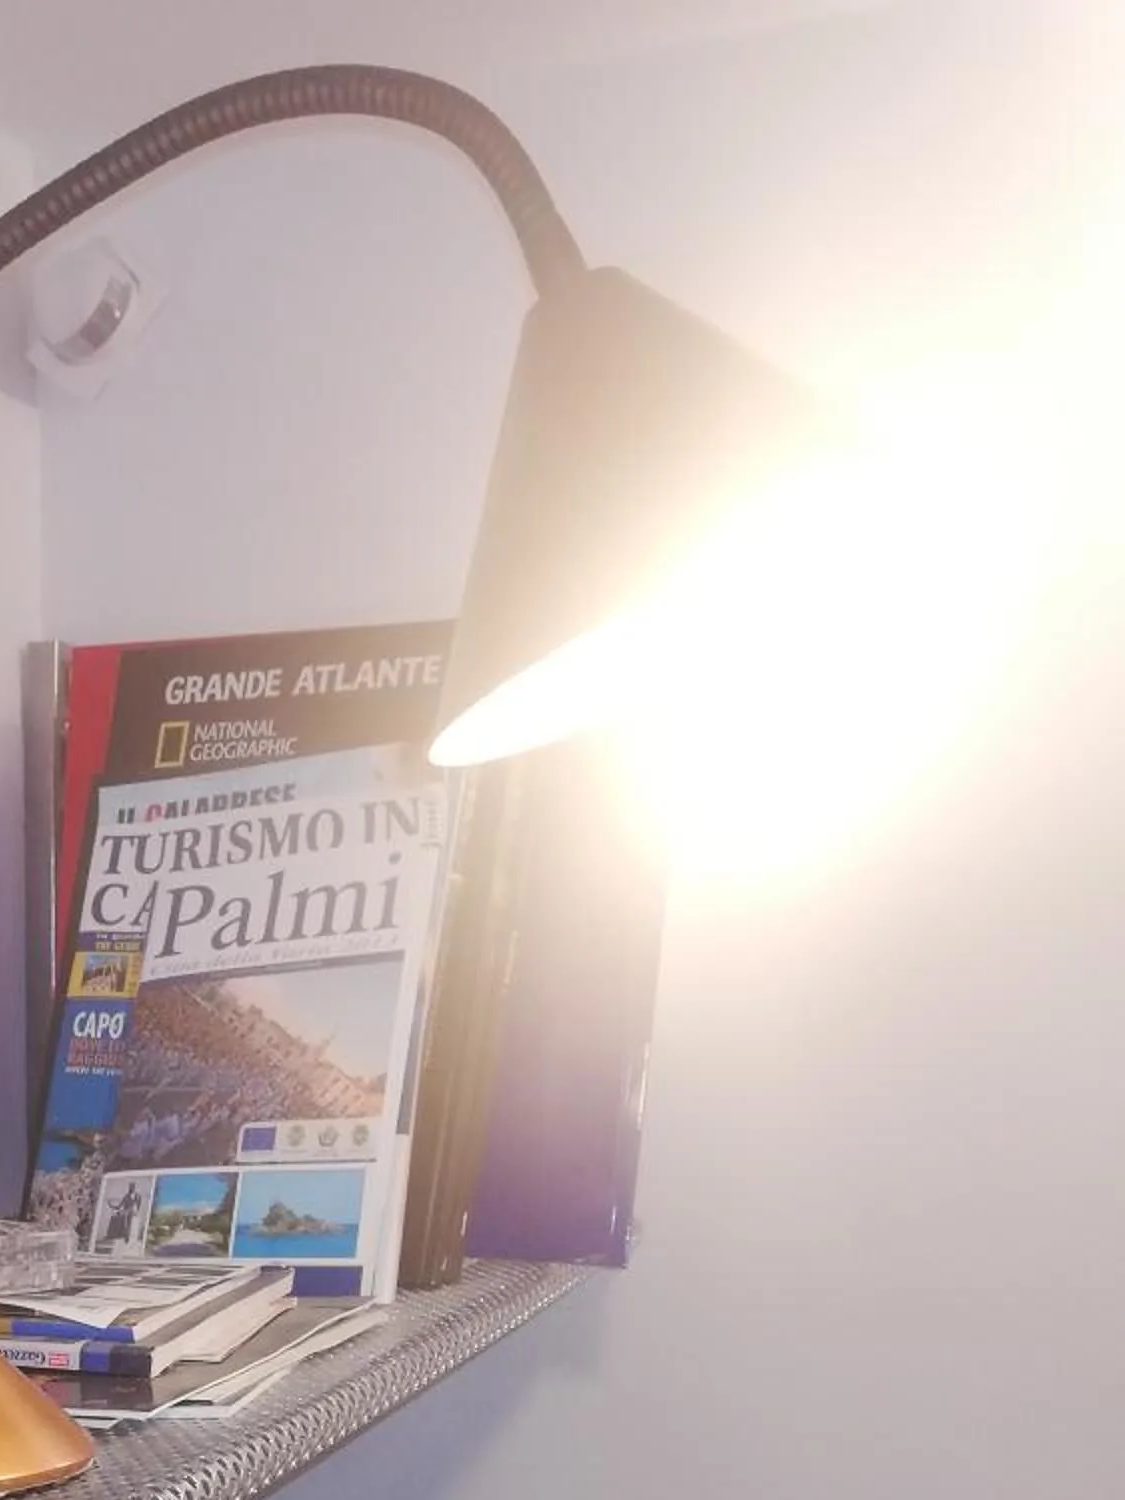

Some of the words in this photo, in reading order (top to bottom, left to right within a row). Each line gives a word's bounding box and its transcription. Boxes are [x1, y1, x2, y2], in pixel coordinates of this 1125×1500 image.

[165, 668, 283, 705] GRANDE
[292, 655, 443, 697] ATLANTE
[190, 737, 298, 762] GEOGRAPHIC
[193, 719, 277, 742] NATIONAL
[101, 808, 345, 876] TURISMO
[360, 798, 421, 845] IN
[155, 852, 405, 959] Palmi
[73, 1011, 126, 1039] CAPO
